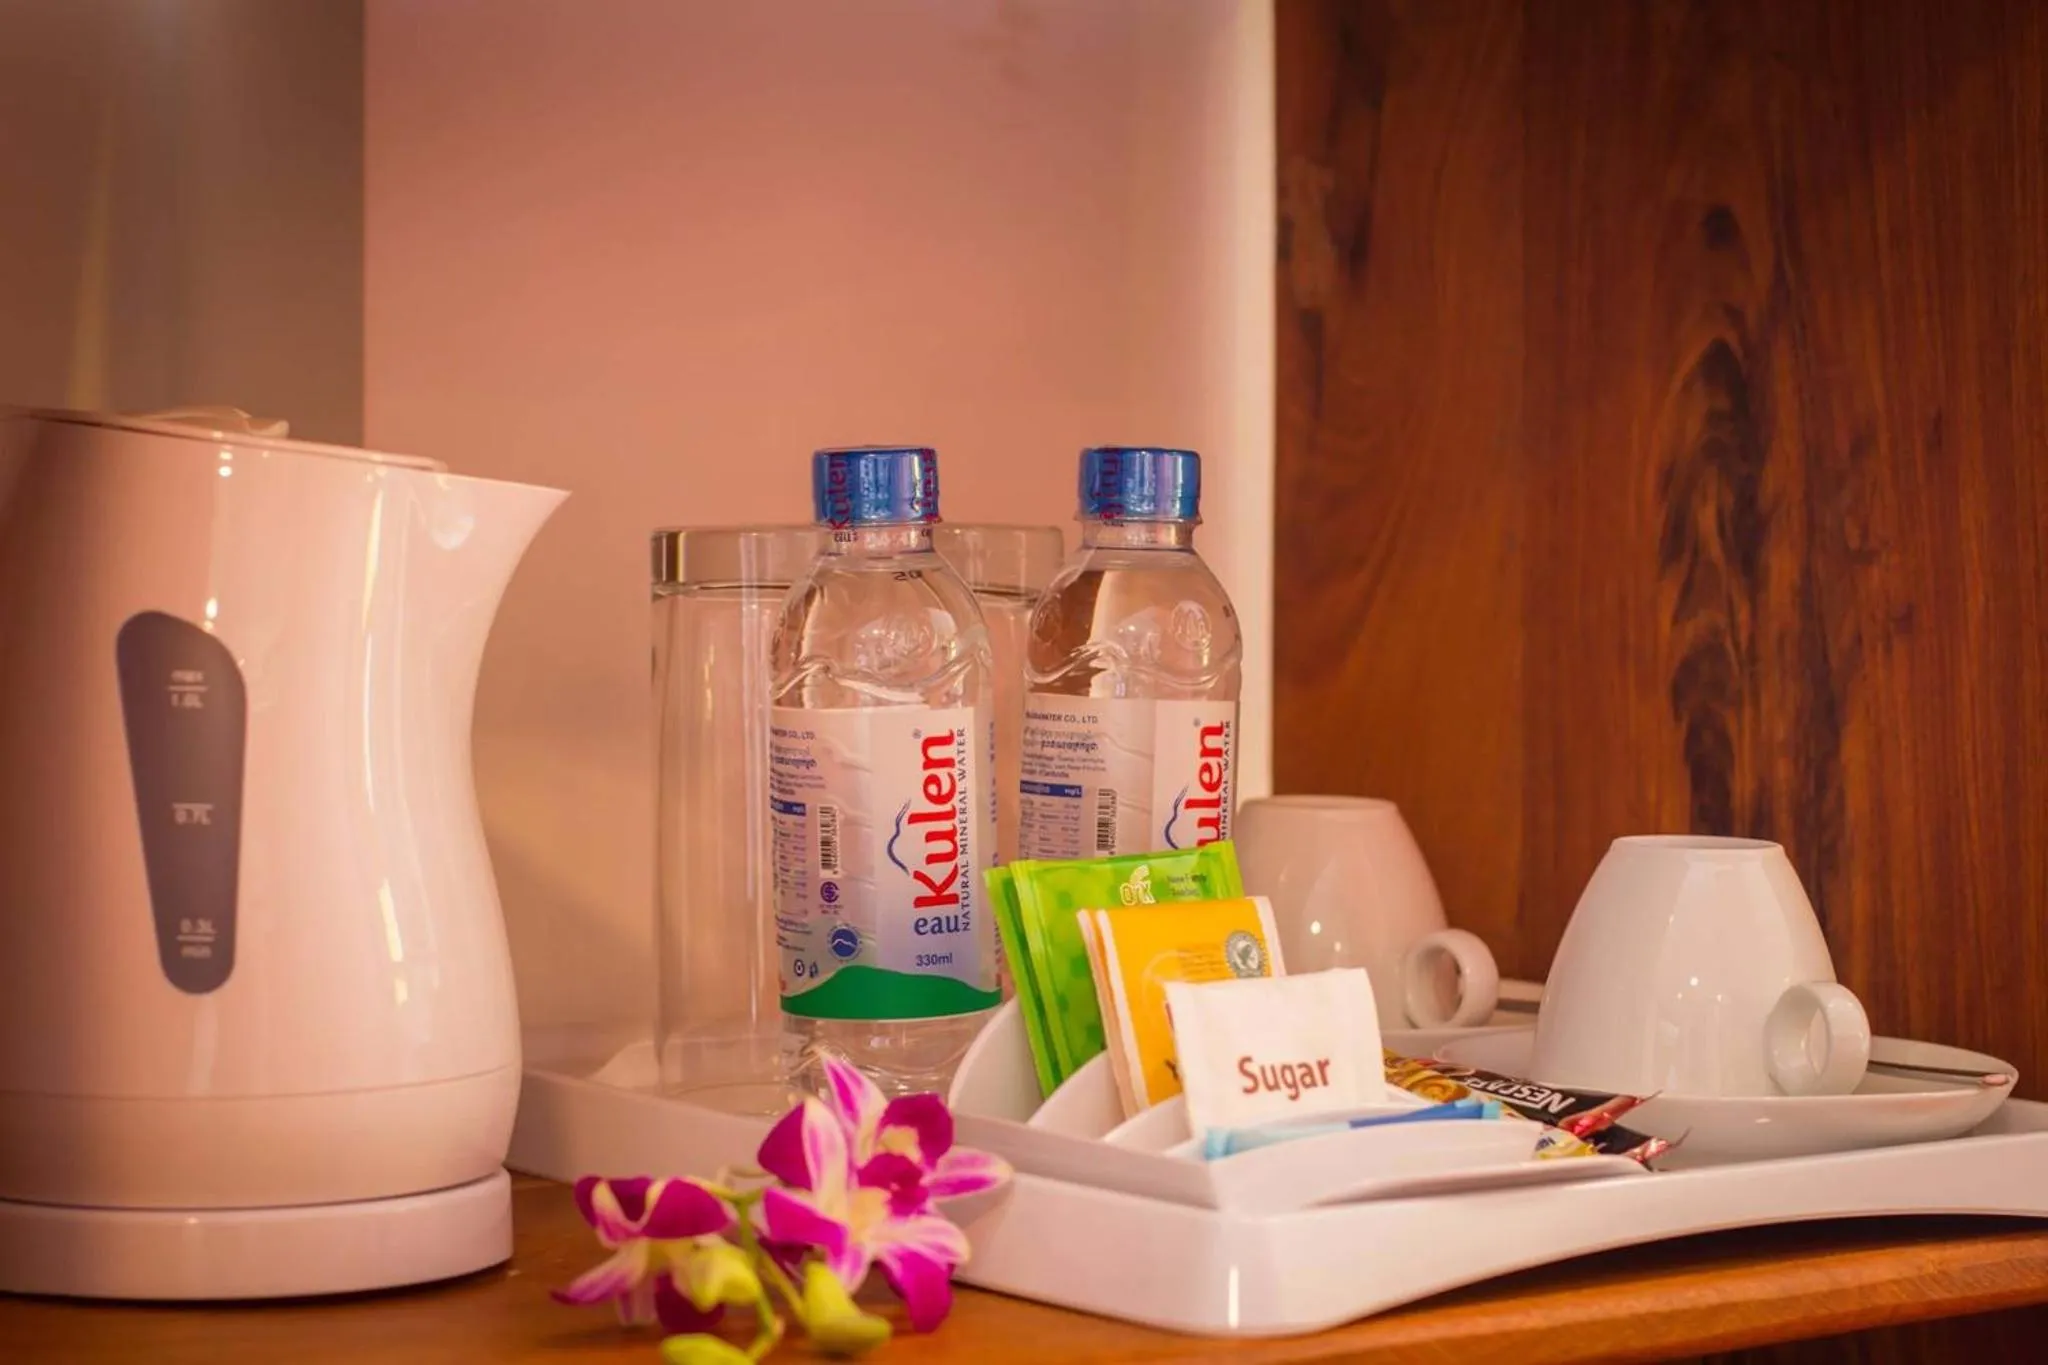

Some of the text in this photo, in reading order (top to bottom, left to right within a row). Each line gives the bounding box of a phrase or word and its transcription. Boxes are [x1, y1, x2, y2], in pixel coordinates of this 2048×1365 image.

[1222, 720, 1232, 773] WATER
[908, 729, 960, 909] Kulen
[956, 728, 971, 932] NATURAL MINERAL WATER
[914, 914, 961, 936] eau
[915, 952, 953, 967] 330ml
[1237, 1055, 1331, 1101] Sugar
